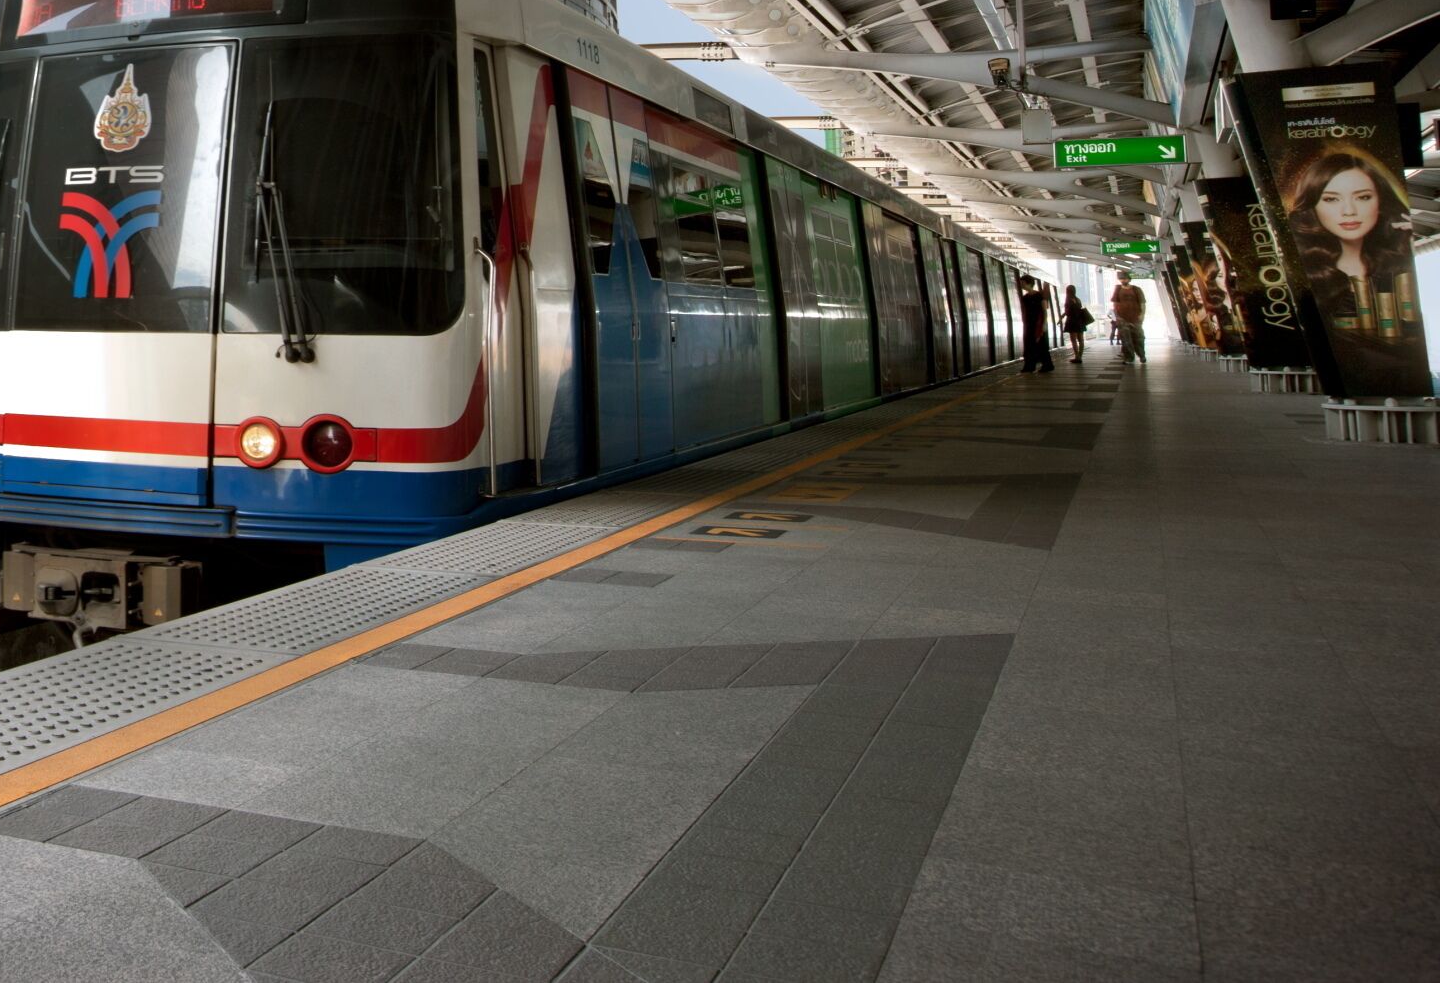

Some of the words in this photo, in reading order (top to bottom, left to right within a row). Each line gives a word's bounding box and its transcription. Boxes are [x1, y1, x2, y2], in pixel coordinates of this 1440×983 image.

[577, 37, 600, 65] 1118
[1064, 142, 1116, 154] ทางออก
[1066, 155, 1088, 163] Exit
[64, 165, 165, 185] BTS
